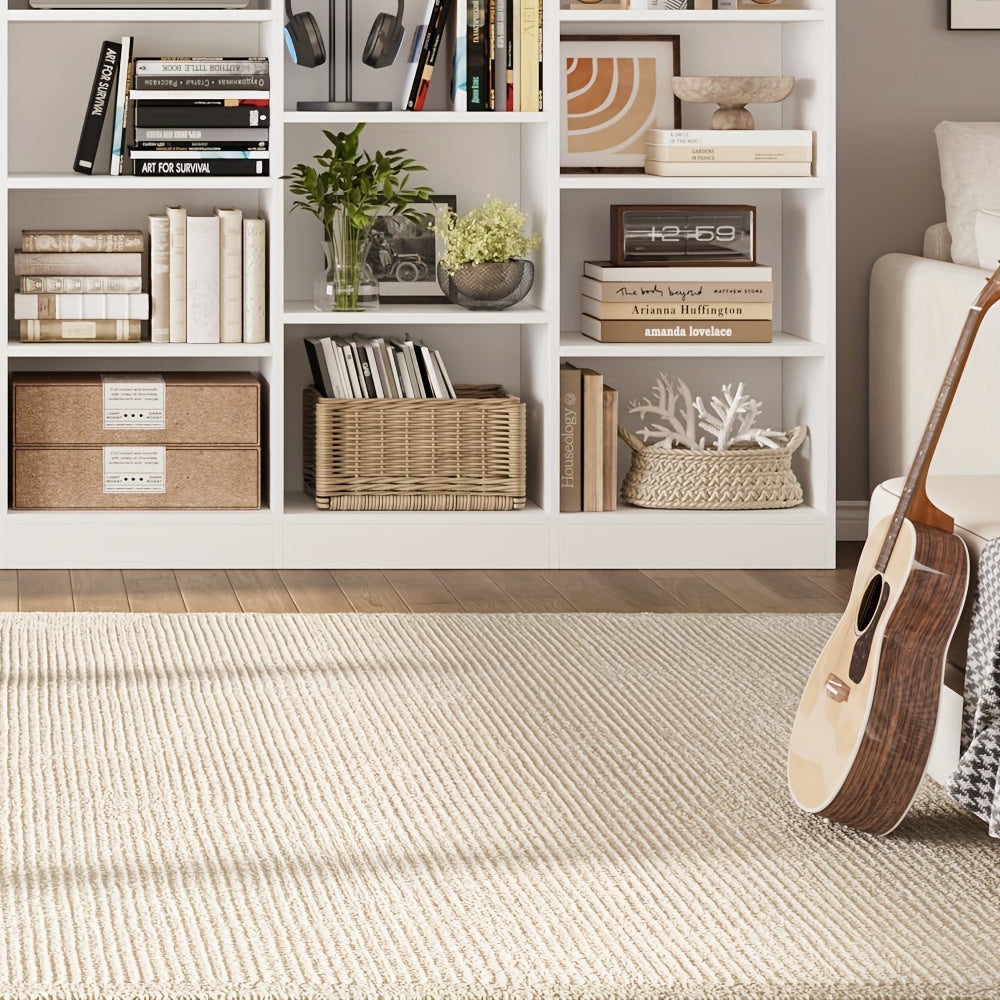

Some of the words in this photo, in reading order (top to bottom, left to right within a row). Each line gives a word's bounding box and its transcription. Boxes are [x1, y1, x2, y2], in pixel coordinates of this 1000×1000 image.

[105, 48, 117, 64] ART
[101, 65, 113, 81] FOR
[162, 64, 182, 72] BOOK
[184, 64, 207, 72] TITLE
[209, 64, 241, 72] AUTHOR
[142, 162, 156, 173] ART
[158, 162, 174, 173] FOR
[176, 162, 211, 173] SURVIVAL
[695, 225, 736, 242] 59
[616, 286, 637, 296] The
[667, 286, 703, 302] beyond
[631, 305, 676, 315] Arianna
[680, 304, 743, 317] Huffington
[644, 326, 686, 337] amanda
[688, 326, 733, 337] lovelace
[561, 409, 577, 489] Houseology
